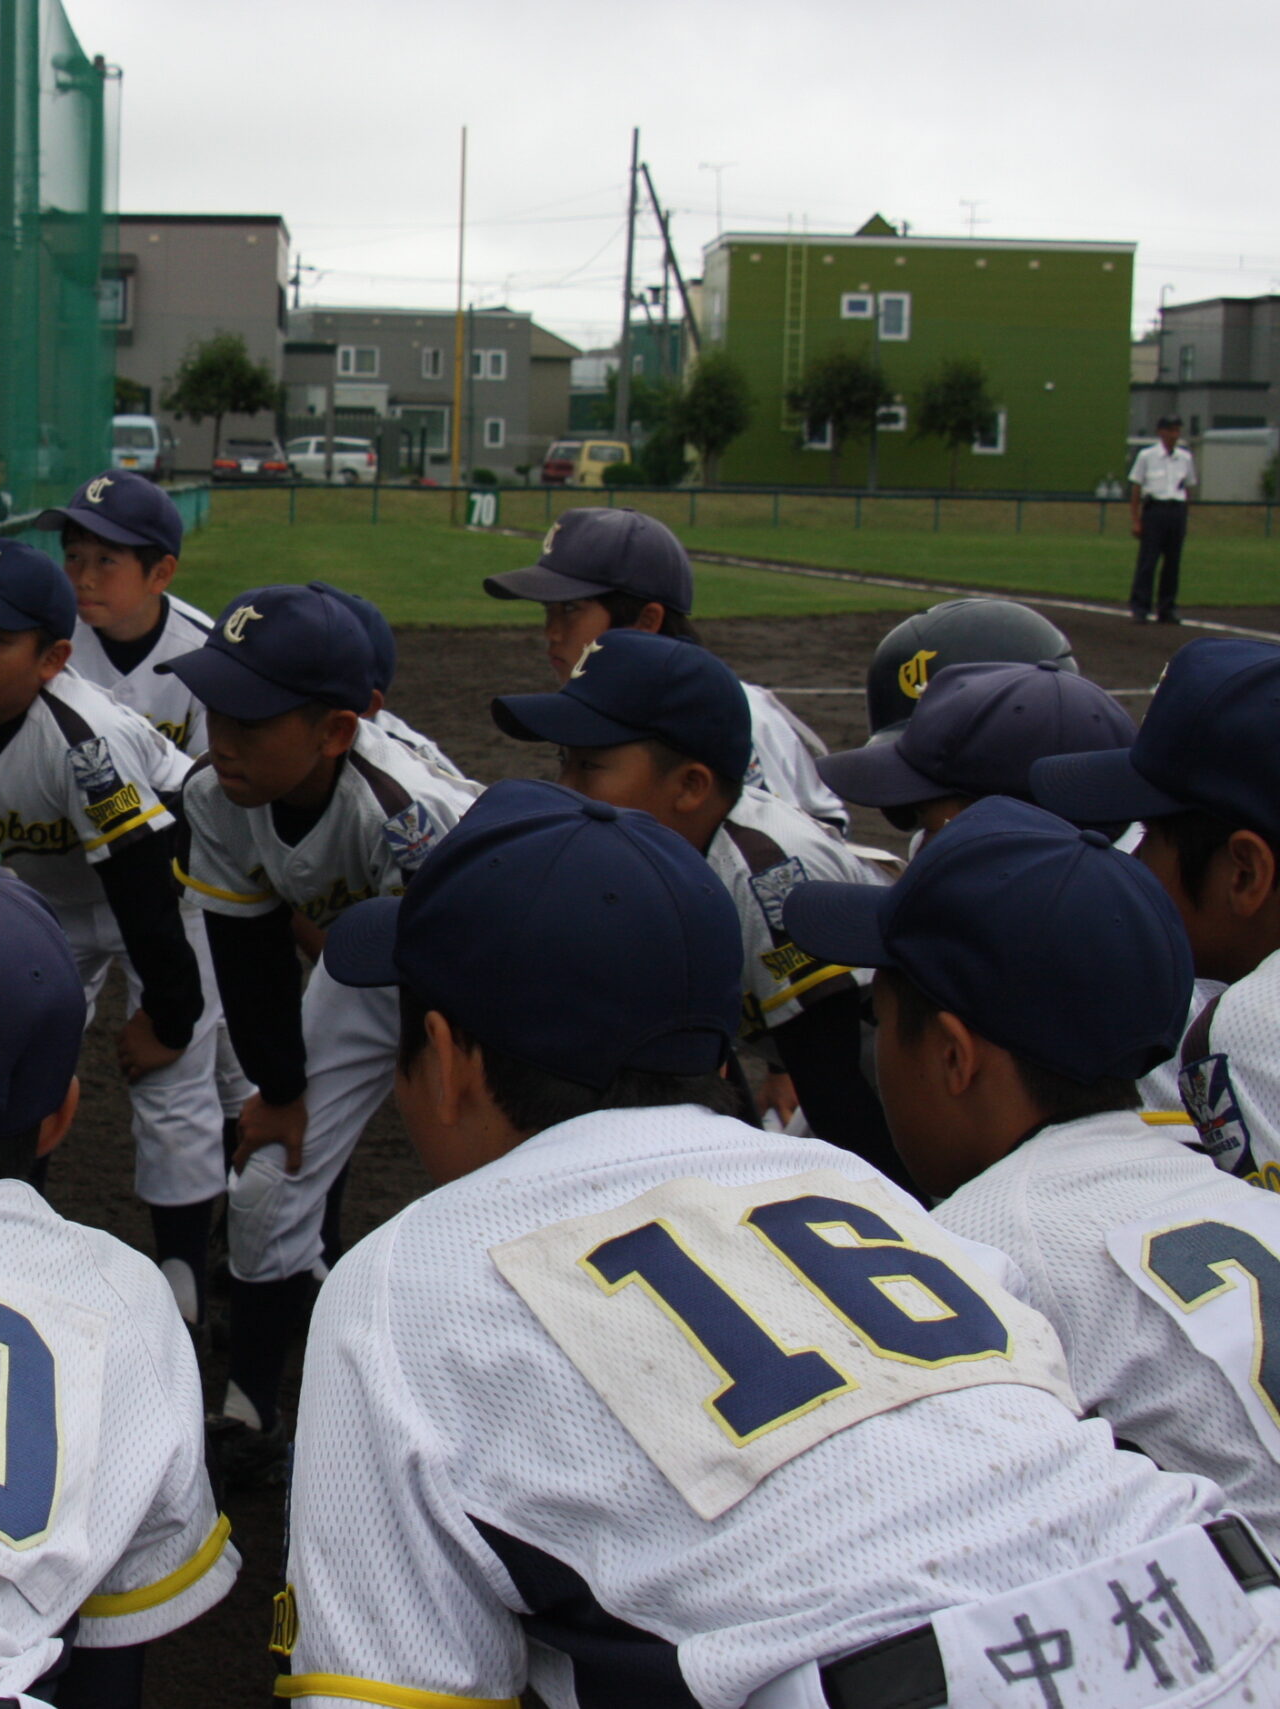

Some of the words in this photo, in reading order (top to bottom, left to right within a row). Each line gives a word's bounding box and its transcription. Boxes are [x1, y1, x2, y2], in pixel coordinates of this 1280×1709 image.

[470, 492, 497, 526] 70
[578, 1194, 1013, 1448] 16
[984, 1560, 1214, 1709] 中村
